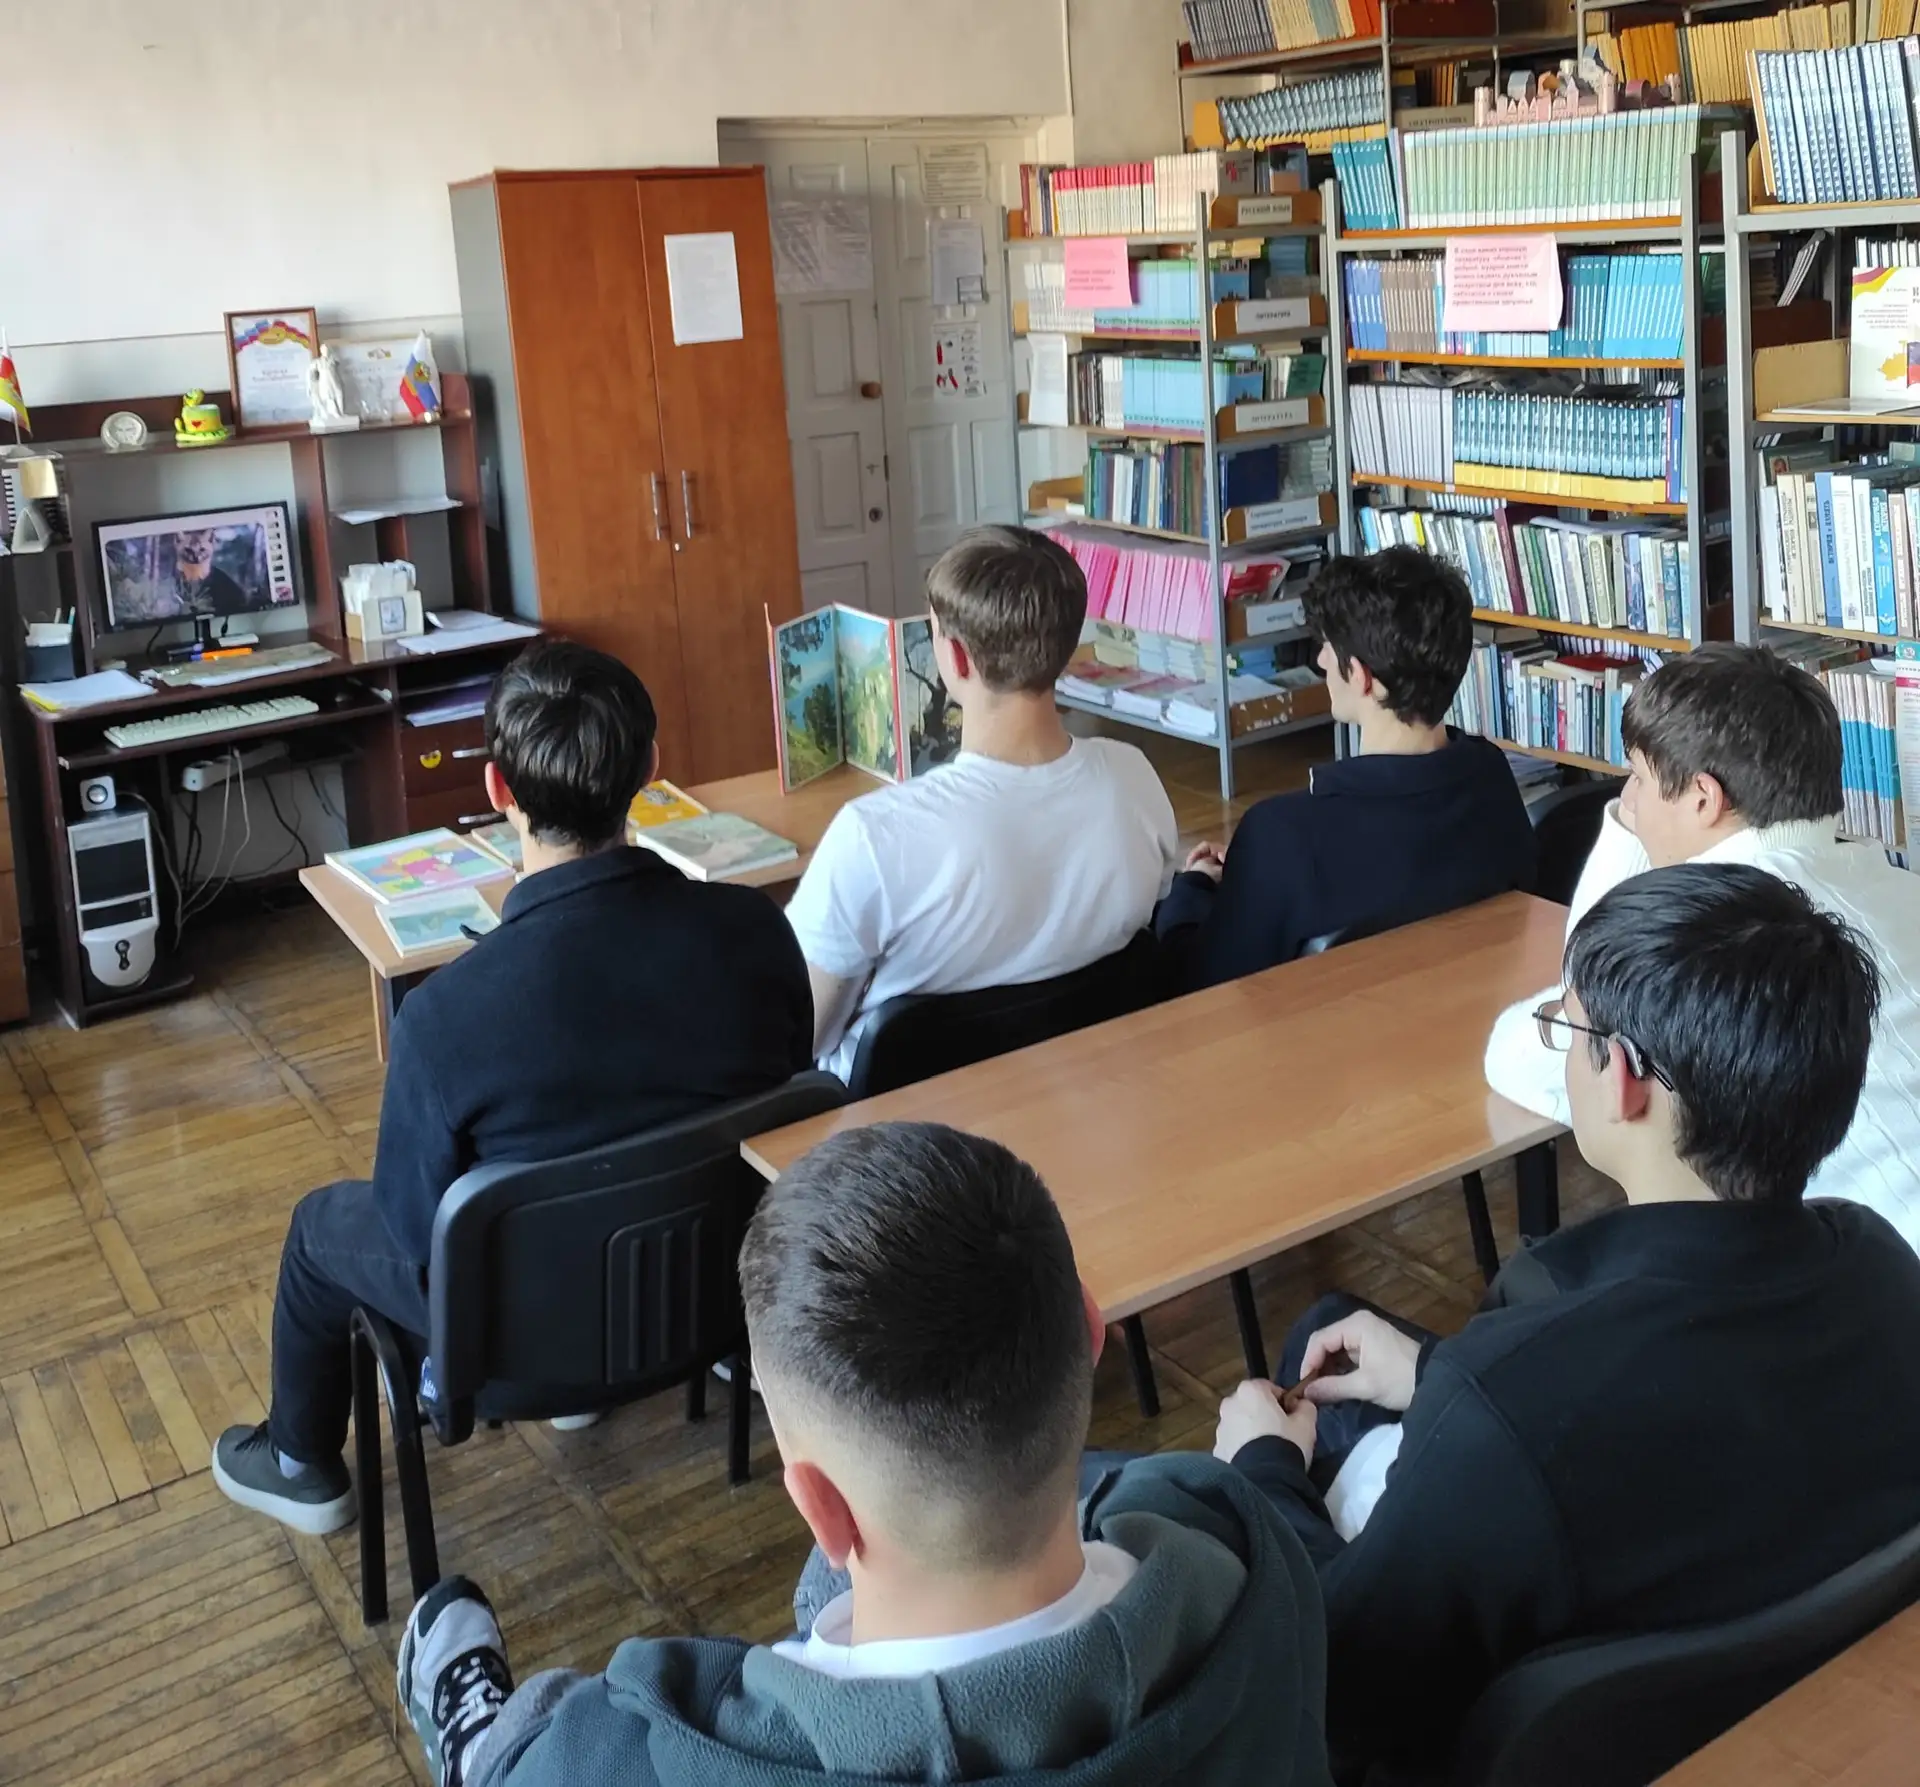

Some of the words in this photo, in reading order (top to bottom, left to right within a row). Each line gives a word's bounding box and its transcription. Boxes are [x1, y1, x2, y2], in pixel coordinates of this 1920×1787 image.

[1241, 206, 1270, 215] РУССКИЙ
[1256, 311, 1290, 319] ЛИТЕРАТУРА
[1251, 413, 1292, 423] ЛИТЕРАТУРА
[1826, 534, 1835, 563] ИСТОРИЯ
